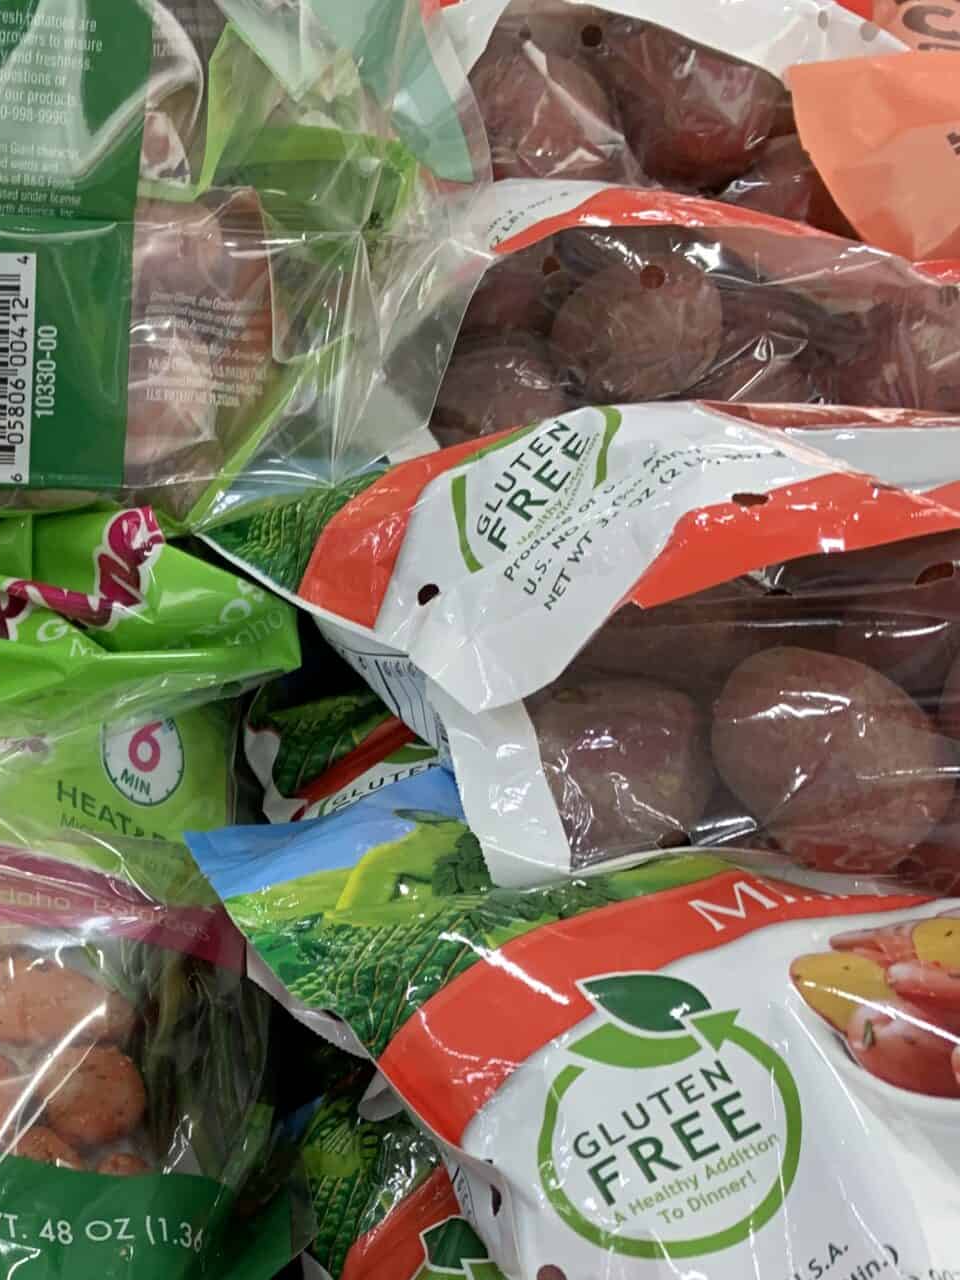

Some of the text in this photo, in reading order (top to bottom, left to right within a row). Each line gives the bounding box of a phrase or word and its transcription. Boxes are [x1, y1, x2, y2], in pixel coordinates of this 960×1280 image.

[7, 255, 29, 482] 6 05806 00412 4
[35, 325, 58, 418] 10330-00
[475, 419, 572, 535] GLUTEN
[487, 431, 590, 552] FREE
[523, 555, 553, 597] U.S.
[543, 572, 573, 612] NET
[567, 531, 594, 565] WT
[120, 768, 152, 796] MIN
[128, 720, 163, 773] 6
[56, 779, 133, 835] HEAT
[573, 1059, 734, 1160] GLUTEN
[587, 1091, 762, 1206] FREE
[630, 1174, 700, 1215] Healthy
[704, 1133, 781, 1180] Addition
[657, 1169, 758, 1224] To Dinner!
[39, 1220, 73, 1245] 48
[85, 1218, 135, 1242] OZ
